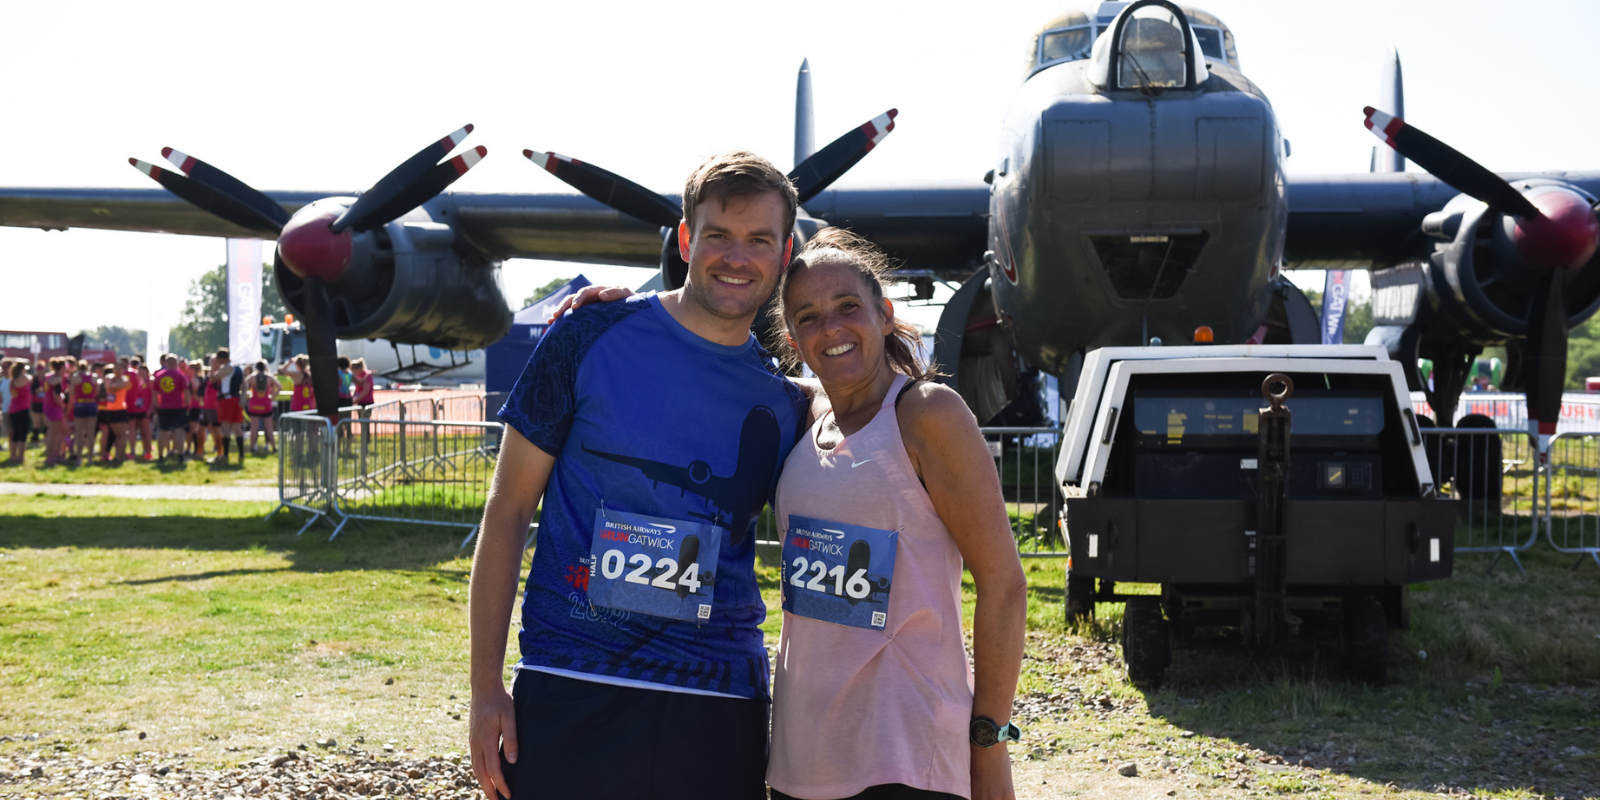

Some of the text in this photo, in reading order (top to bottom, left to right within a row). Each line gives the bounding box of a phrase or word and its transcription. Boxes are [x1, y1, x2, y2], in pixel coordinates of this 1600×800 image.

[605, 521, 662, 536] BRITISH AIRWAYS
[811, 531, 833, 542] AIRWAYS
[589, 553, 598, 577] HALF
[601, 549, 701, 593] 0224
[789, 556, 871, 599] 2216
